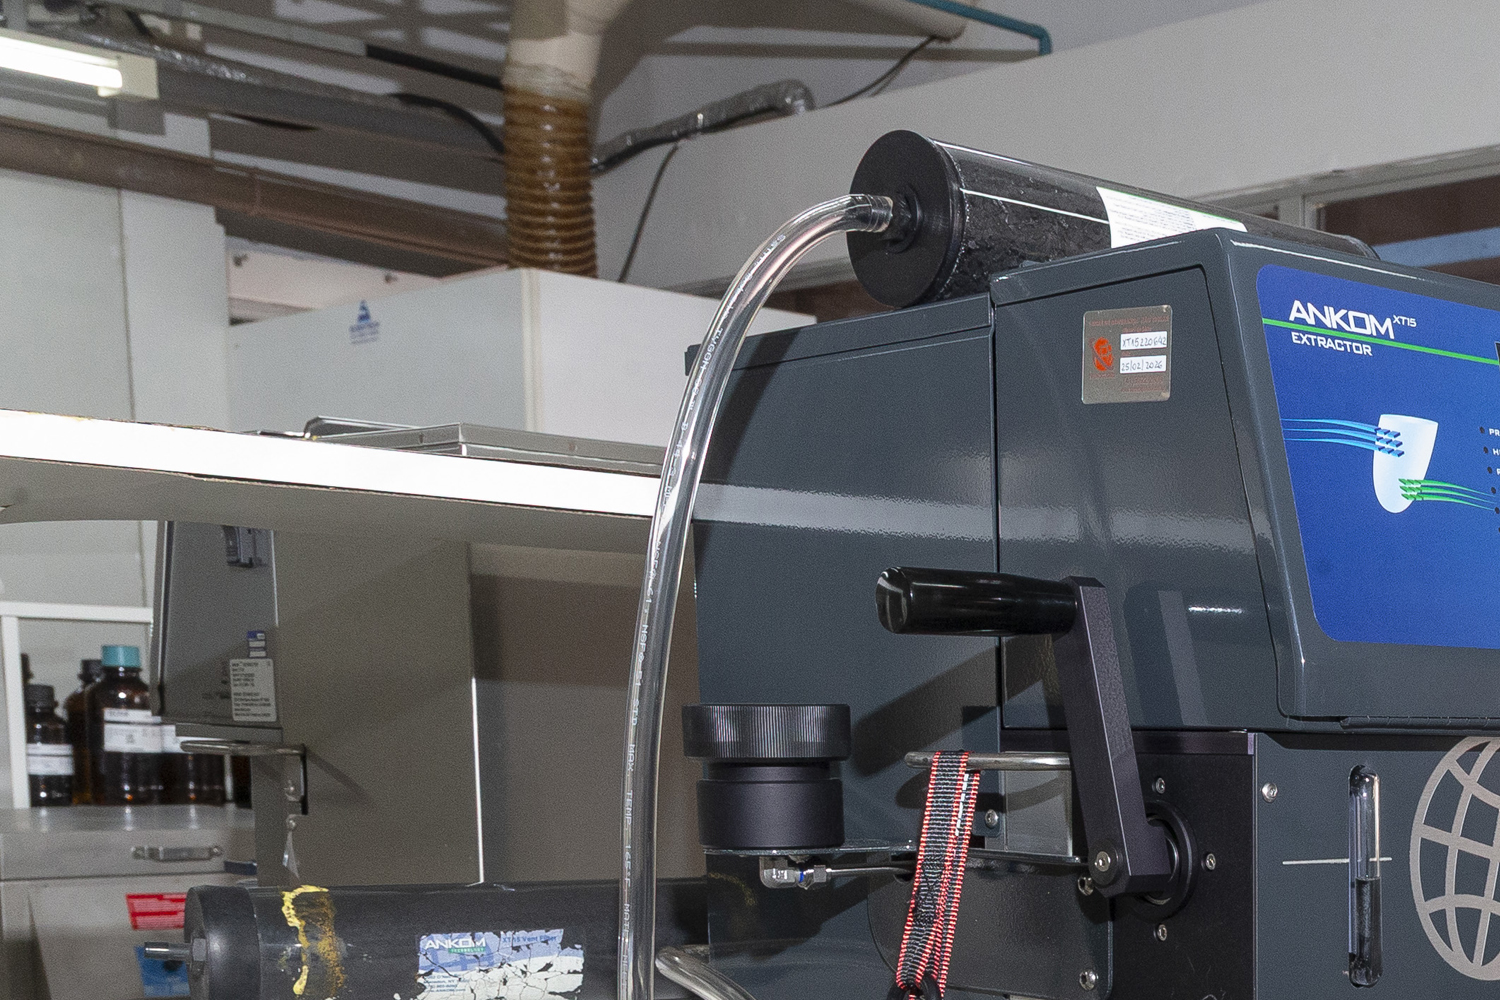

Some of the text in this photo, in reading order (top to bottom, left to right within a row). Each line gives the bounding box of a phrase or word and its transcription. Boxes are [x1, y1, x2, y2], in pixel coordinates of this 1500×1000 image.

[1288, 300, 1418, 340] ANKOM XT15
[1291, 332, 1373, 356] EXTRACTOR
[424, 937, 486, 950] ANKOM
